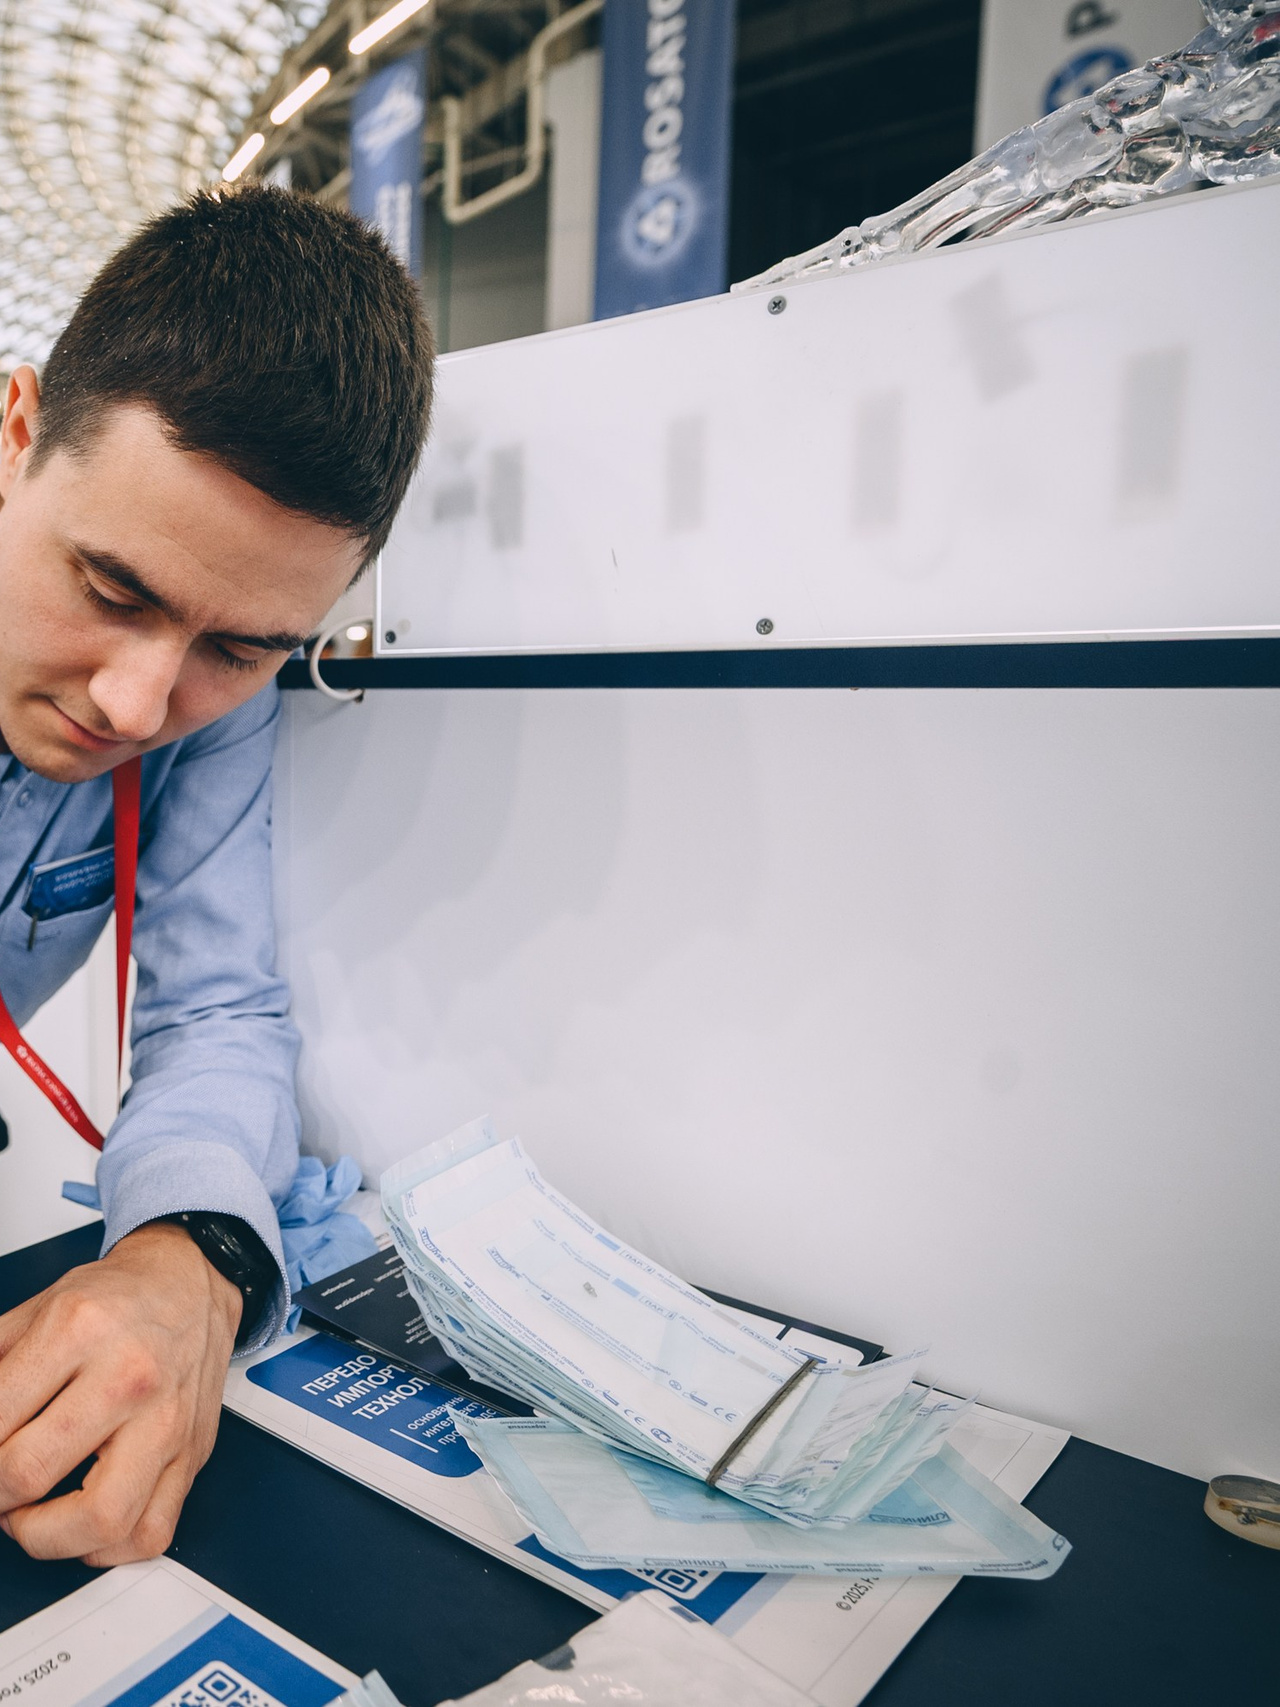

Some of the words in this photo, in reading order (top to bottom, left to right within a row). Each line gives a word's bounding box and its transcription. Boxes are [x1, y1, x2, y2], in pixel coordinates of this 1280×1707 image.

[301, 1355, 377, 1395] ПЕРЕДО
[326, 1362, 408, 1409] ИМПОРТ
[352, 1376, 431, 1421] ТЕХНОЛ
